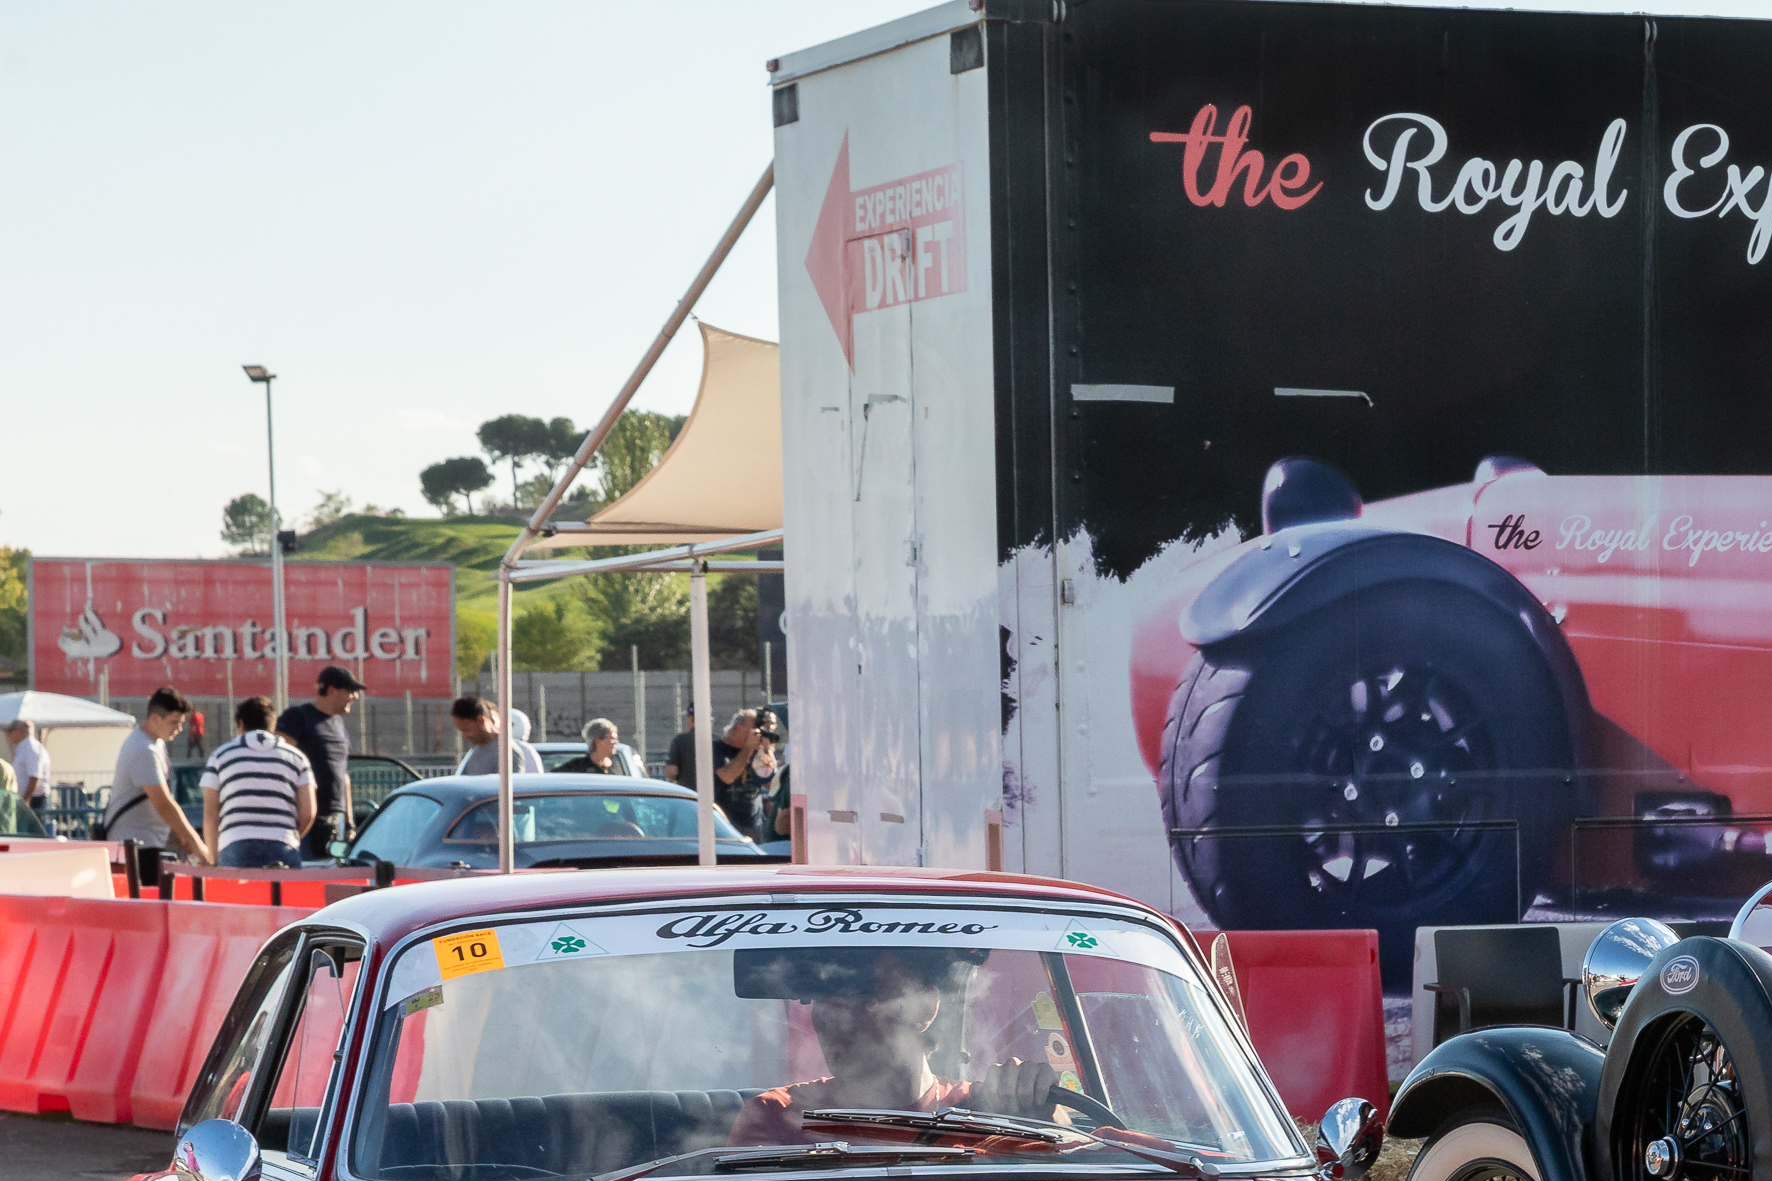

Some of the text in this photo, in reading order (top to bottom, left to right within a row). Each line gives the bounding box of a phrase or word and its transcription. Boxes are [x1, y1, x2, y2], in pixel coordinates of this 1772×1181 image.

[855, 168, 962, 232] EXPERIENCIA
[1150, 104, 1324, 210] the
[1363, 112, 1627, 251] Royal
[863, 220, 954, 309] DRIFT
[1486, 514, 1543, 551] the
[1554, 514, 1651, 562] Royal
[131, 607, 430, 662] Santander
[452, 942, 487, 961] 10
[656, 908, 998, 947] Alfa Romeo
[1667, 963, 1692, 983] Ford
